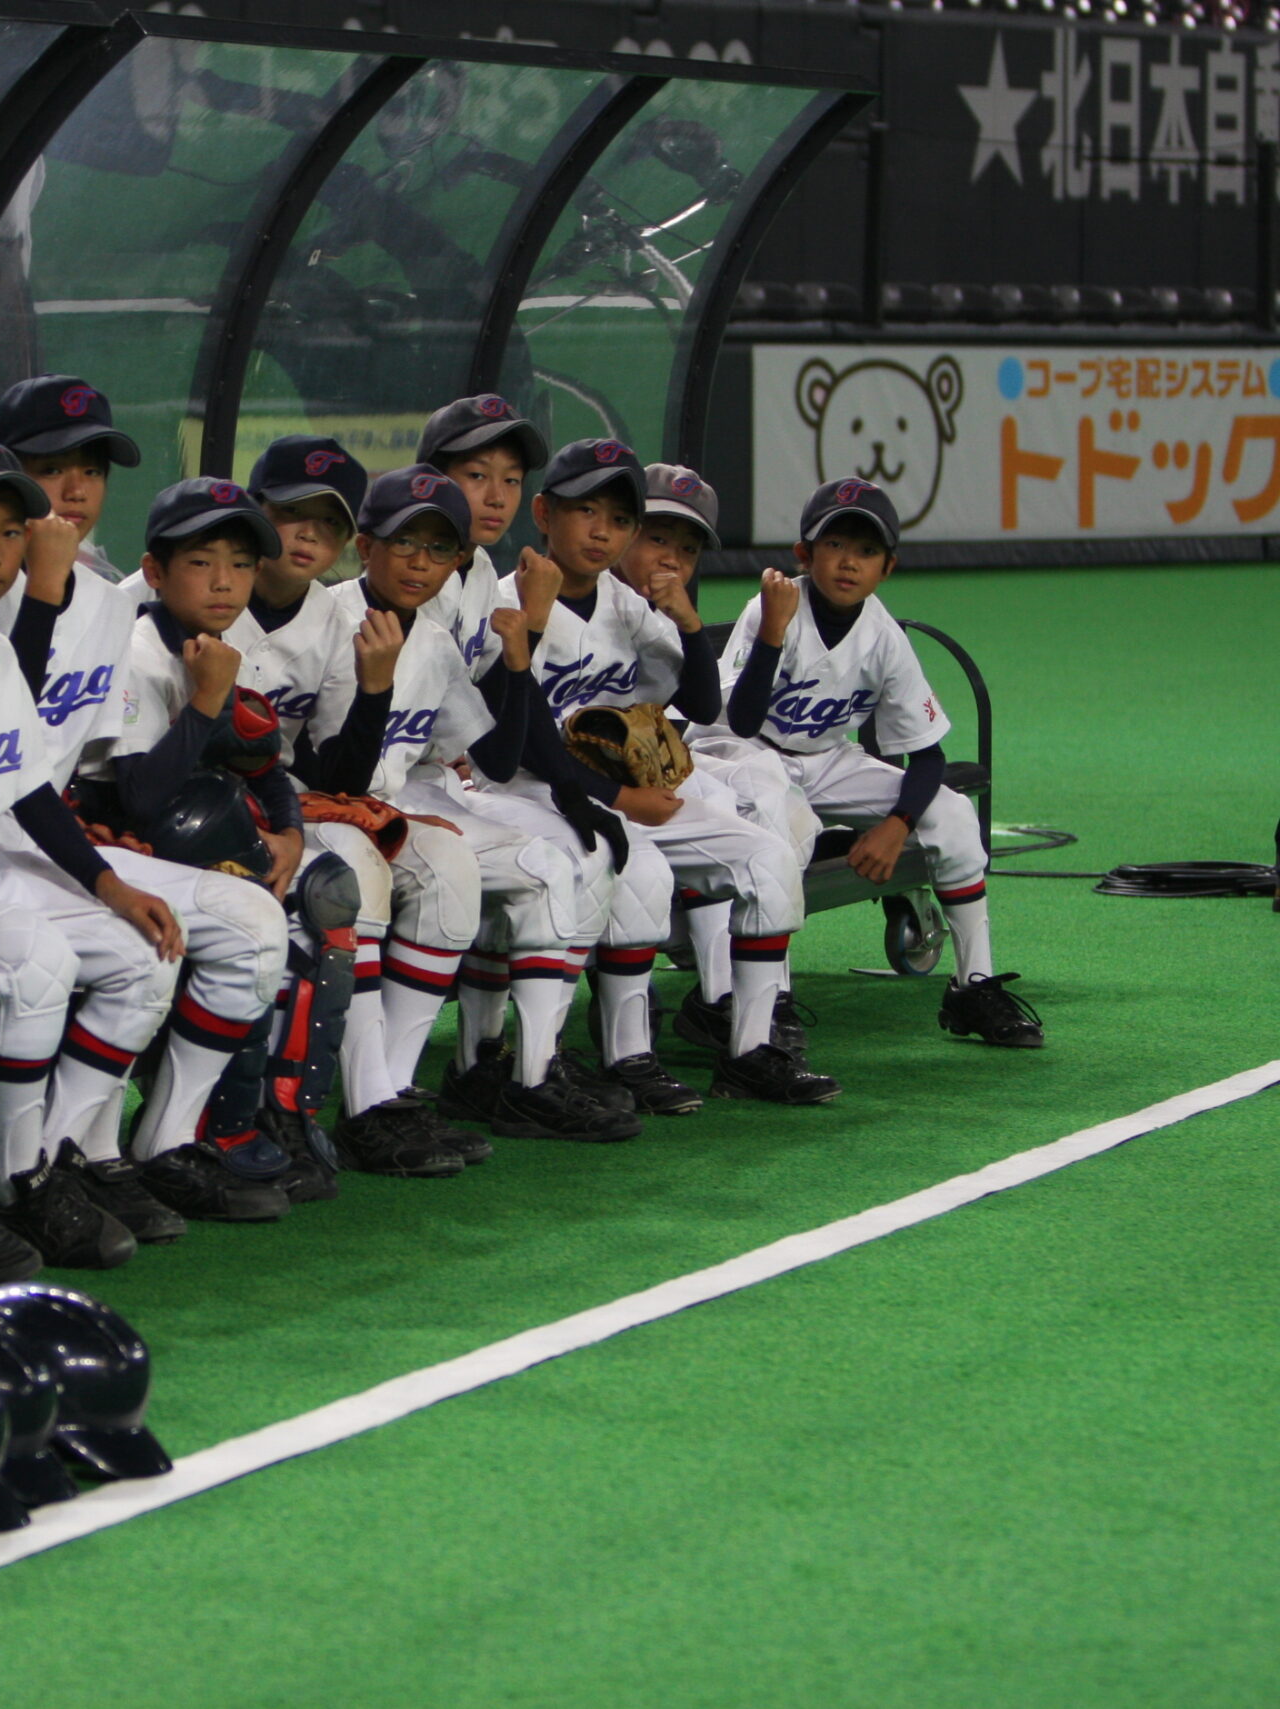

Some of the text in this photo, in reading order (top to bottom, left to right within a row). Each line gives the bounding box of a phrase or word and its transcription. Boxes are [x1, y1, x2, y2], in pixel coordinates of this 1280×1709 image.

[1027, 358, 1267, 398] コープ宅配システム
[1001, 409, 1280, 530] トドック
